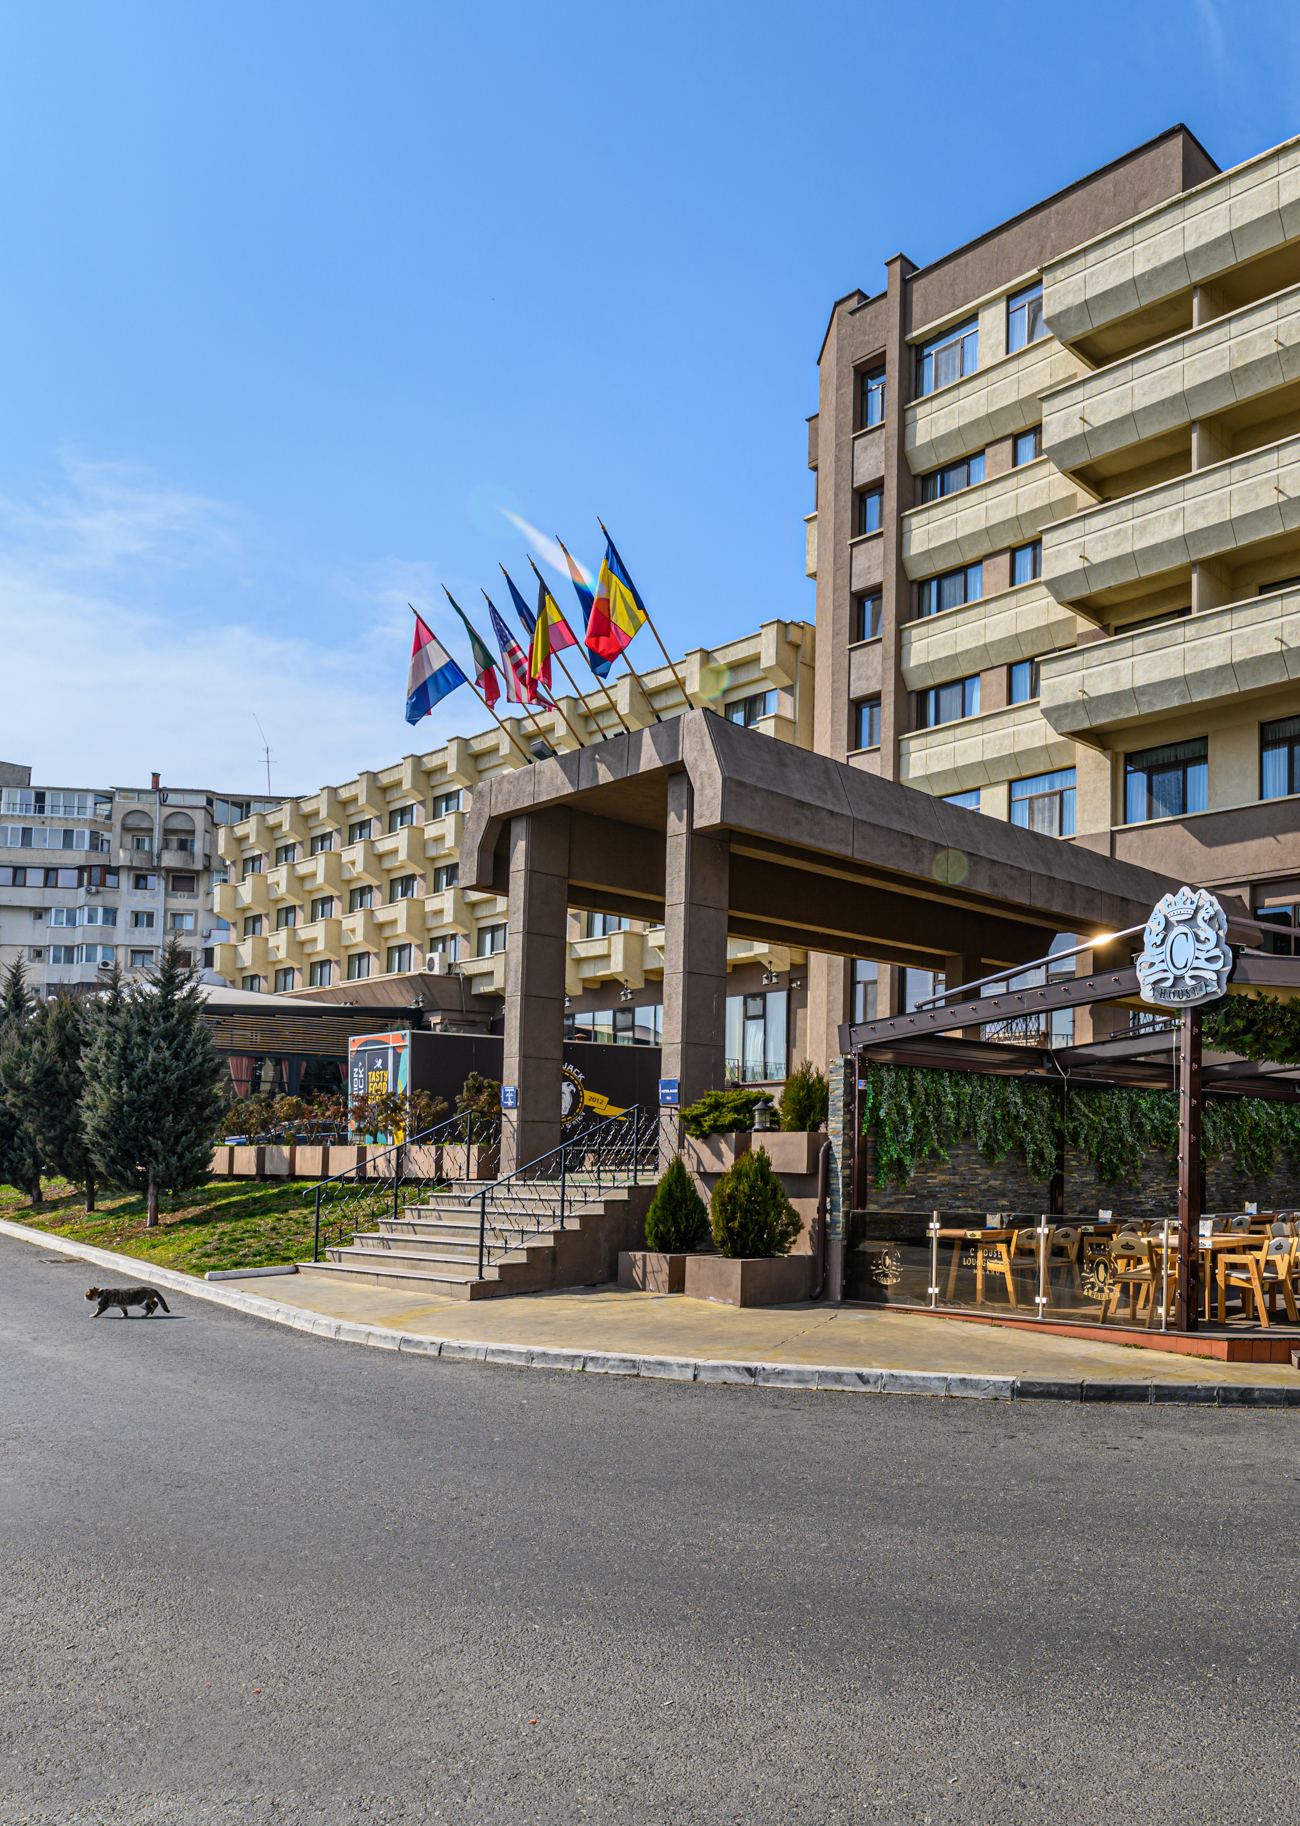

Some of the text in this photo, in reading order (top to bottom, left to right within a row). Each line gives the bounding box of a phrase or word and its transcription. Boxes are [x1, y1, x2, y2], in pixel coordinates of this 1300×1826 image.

[1169, 932, 1190, 969] C
[1160, 985, 1200, 1000] HOUSE
[368, 1070, 388, 1083] TASTY
[562, 1062, 586, 1081] JACK
[368, 1082, 388, 1095] FOOD
[588, 1095, 604, 1106] 2012
